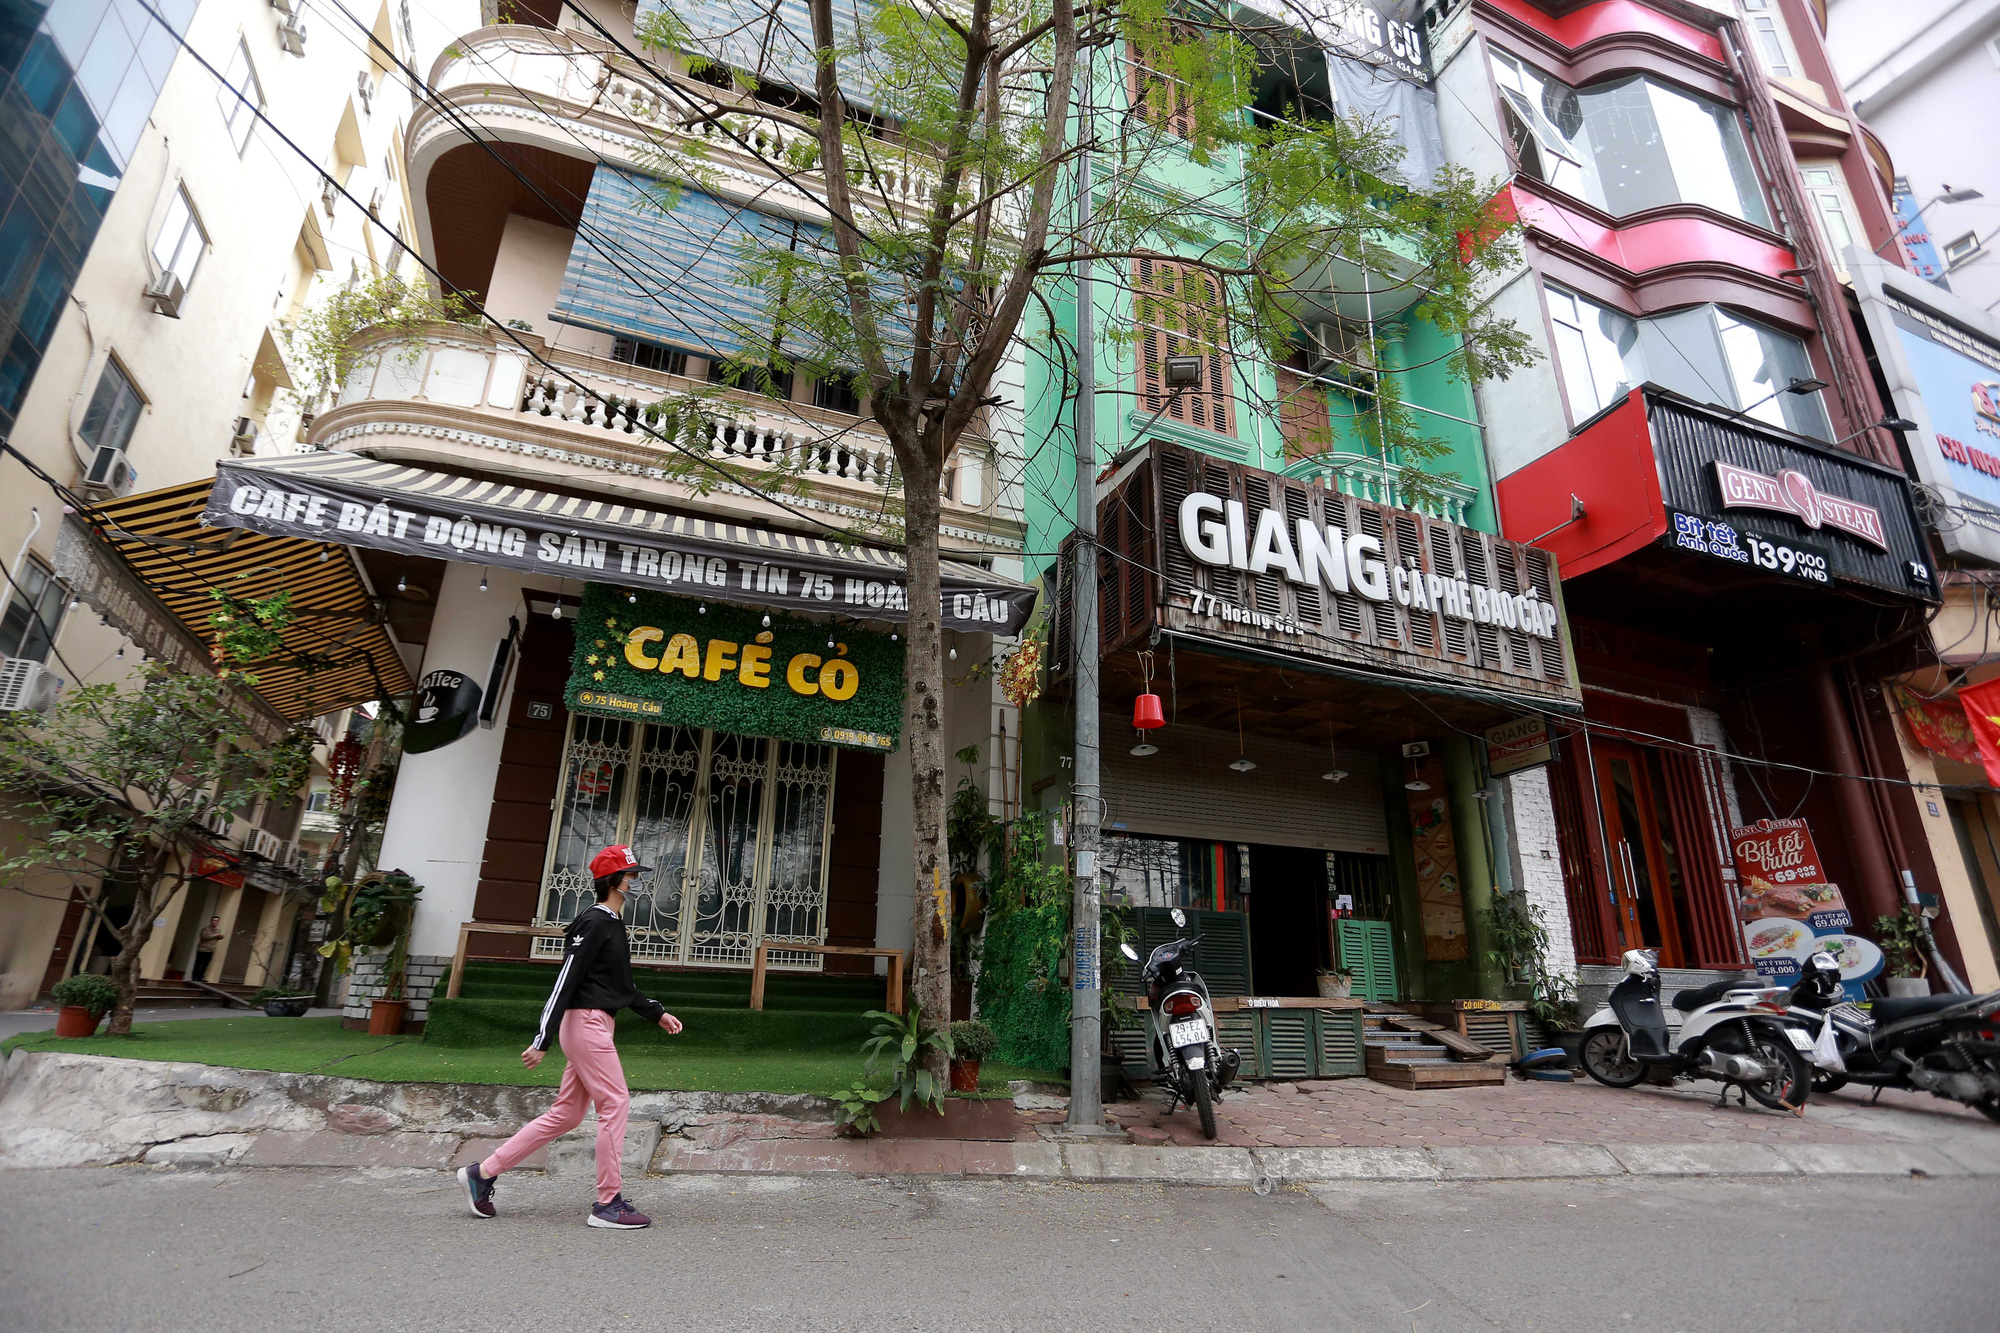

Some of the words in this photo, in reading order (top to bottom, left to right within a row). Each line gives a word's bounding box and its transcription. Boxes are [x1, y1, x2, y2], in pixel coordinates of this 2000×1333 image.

[1936, 433, 1968, 466] CHI
[1727, 472, 1778, 503] GENT
[1822, 501, 1877, 541] STEAK
[1705, 521, 1738, 546] tết
[230, 485, 329, 526] CAFE
[336, 496, 417, 539] BẤT
[422, 515, 527, 558] ĐỘNG
[537, 529, 608, 569] SẢN
[618, 543, 727, 587] TRỌNG
[738, 559, 790, 595] TÍN
[800, 571, 834, 602] 75
[953, 588, 1010, 624] CẦU
[1178, 491, 1390, 601] GIANG
[1676, 533, 1708, 553] Anh
[1708, 537, 1749, 563] Quốc
[1909, 561, 1928, 579] 79
[1187, 589, 1221, 618] 77
[1221, 601, 1272, 628] Hoàng
[624, 625, 775, 689] CAFÉ
[786, 642, 860, 701] CỎ
[532, 704, 548, 717] 75
[595, 694, 607, 706] 75
[608, 696, 639, 713] Hoàng
[833, 729, 854, 741] 0919
[856, 732, 874, 744] 989
[876, 735, 892, 748] 765
[1491, 720, 1539, 744] GIANG
[1060, 756, 1073, 769] 77
[1734, 826, 1756, 837] GENT
[1773, 819, 1798, 829] STEAK
[1777, 830, 1805, 852] tết
[1815, 917, 1849, 928] 69.000
[1765, 966, 1795, 975] 58.000
[1174, 1021, 1201, 1034] 29-E2
[1175, 1031, 1206, 1046] 454.84
